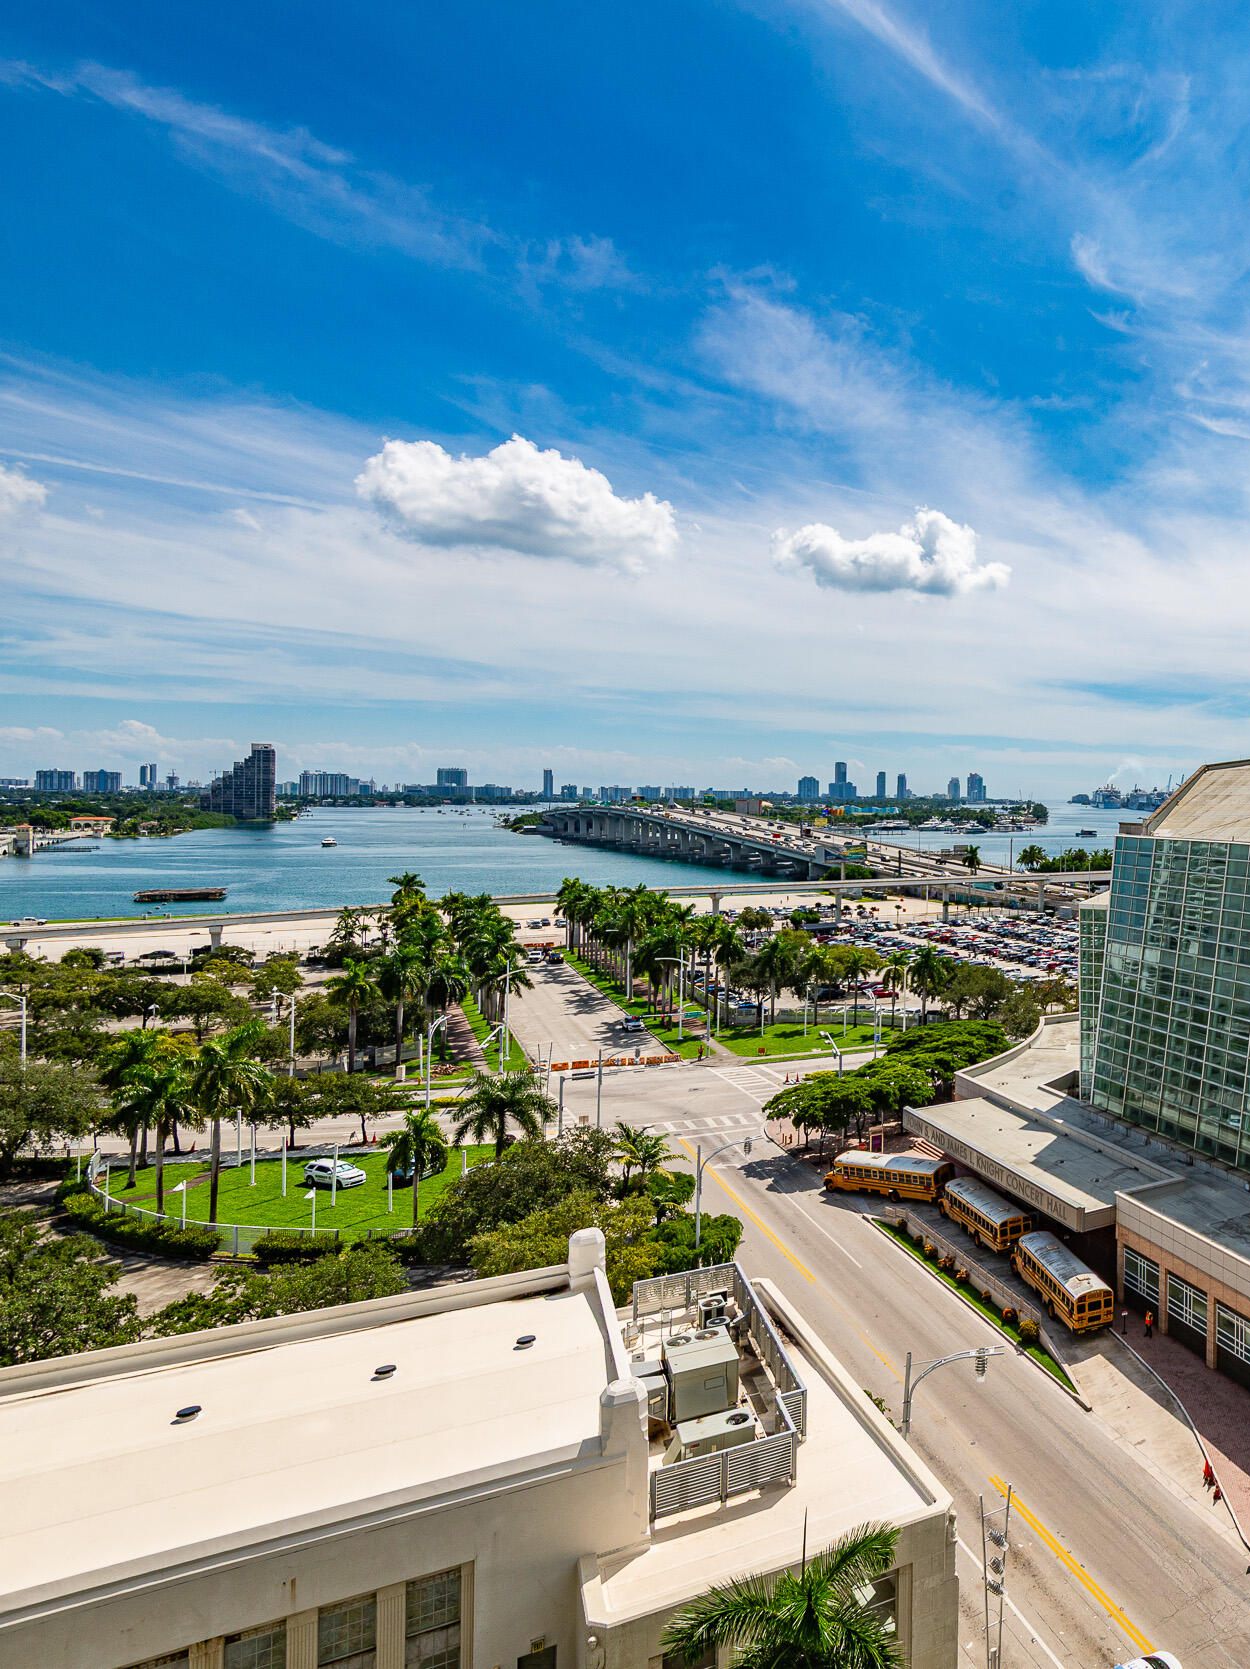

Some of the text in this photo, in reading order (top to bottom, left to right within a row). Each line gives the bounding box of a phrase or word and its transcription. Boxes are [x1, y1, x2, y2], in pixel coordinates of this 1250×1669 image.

[907, 1114, 923, 1136] JOHN
[930, 1130, 945, 1146] AND
[946, 1139, 968, 1160] JAMES
[976, 1155, 1005, 1183] KNIGHT
[1006, 1174, 1043, 1205] CONCERT
[1047, 1197, 1067, 1221] HALL
